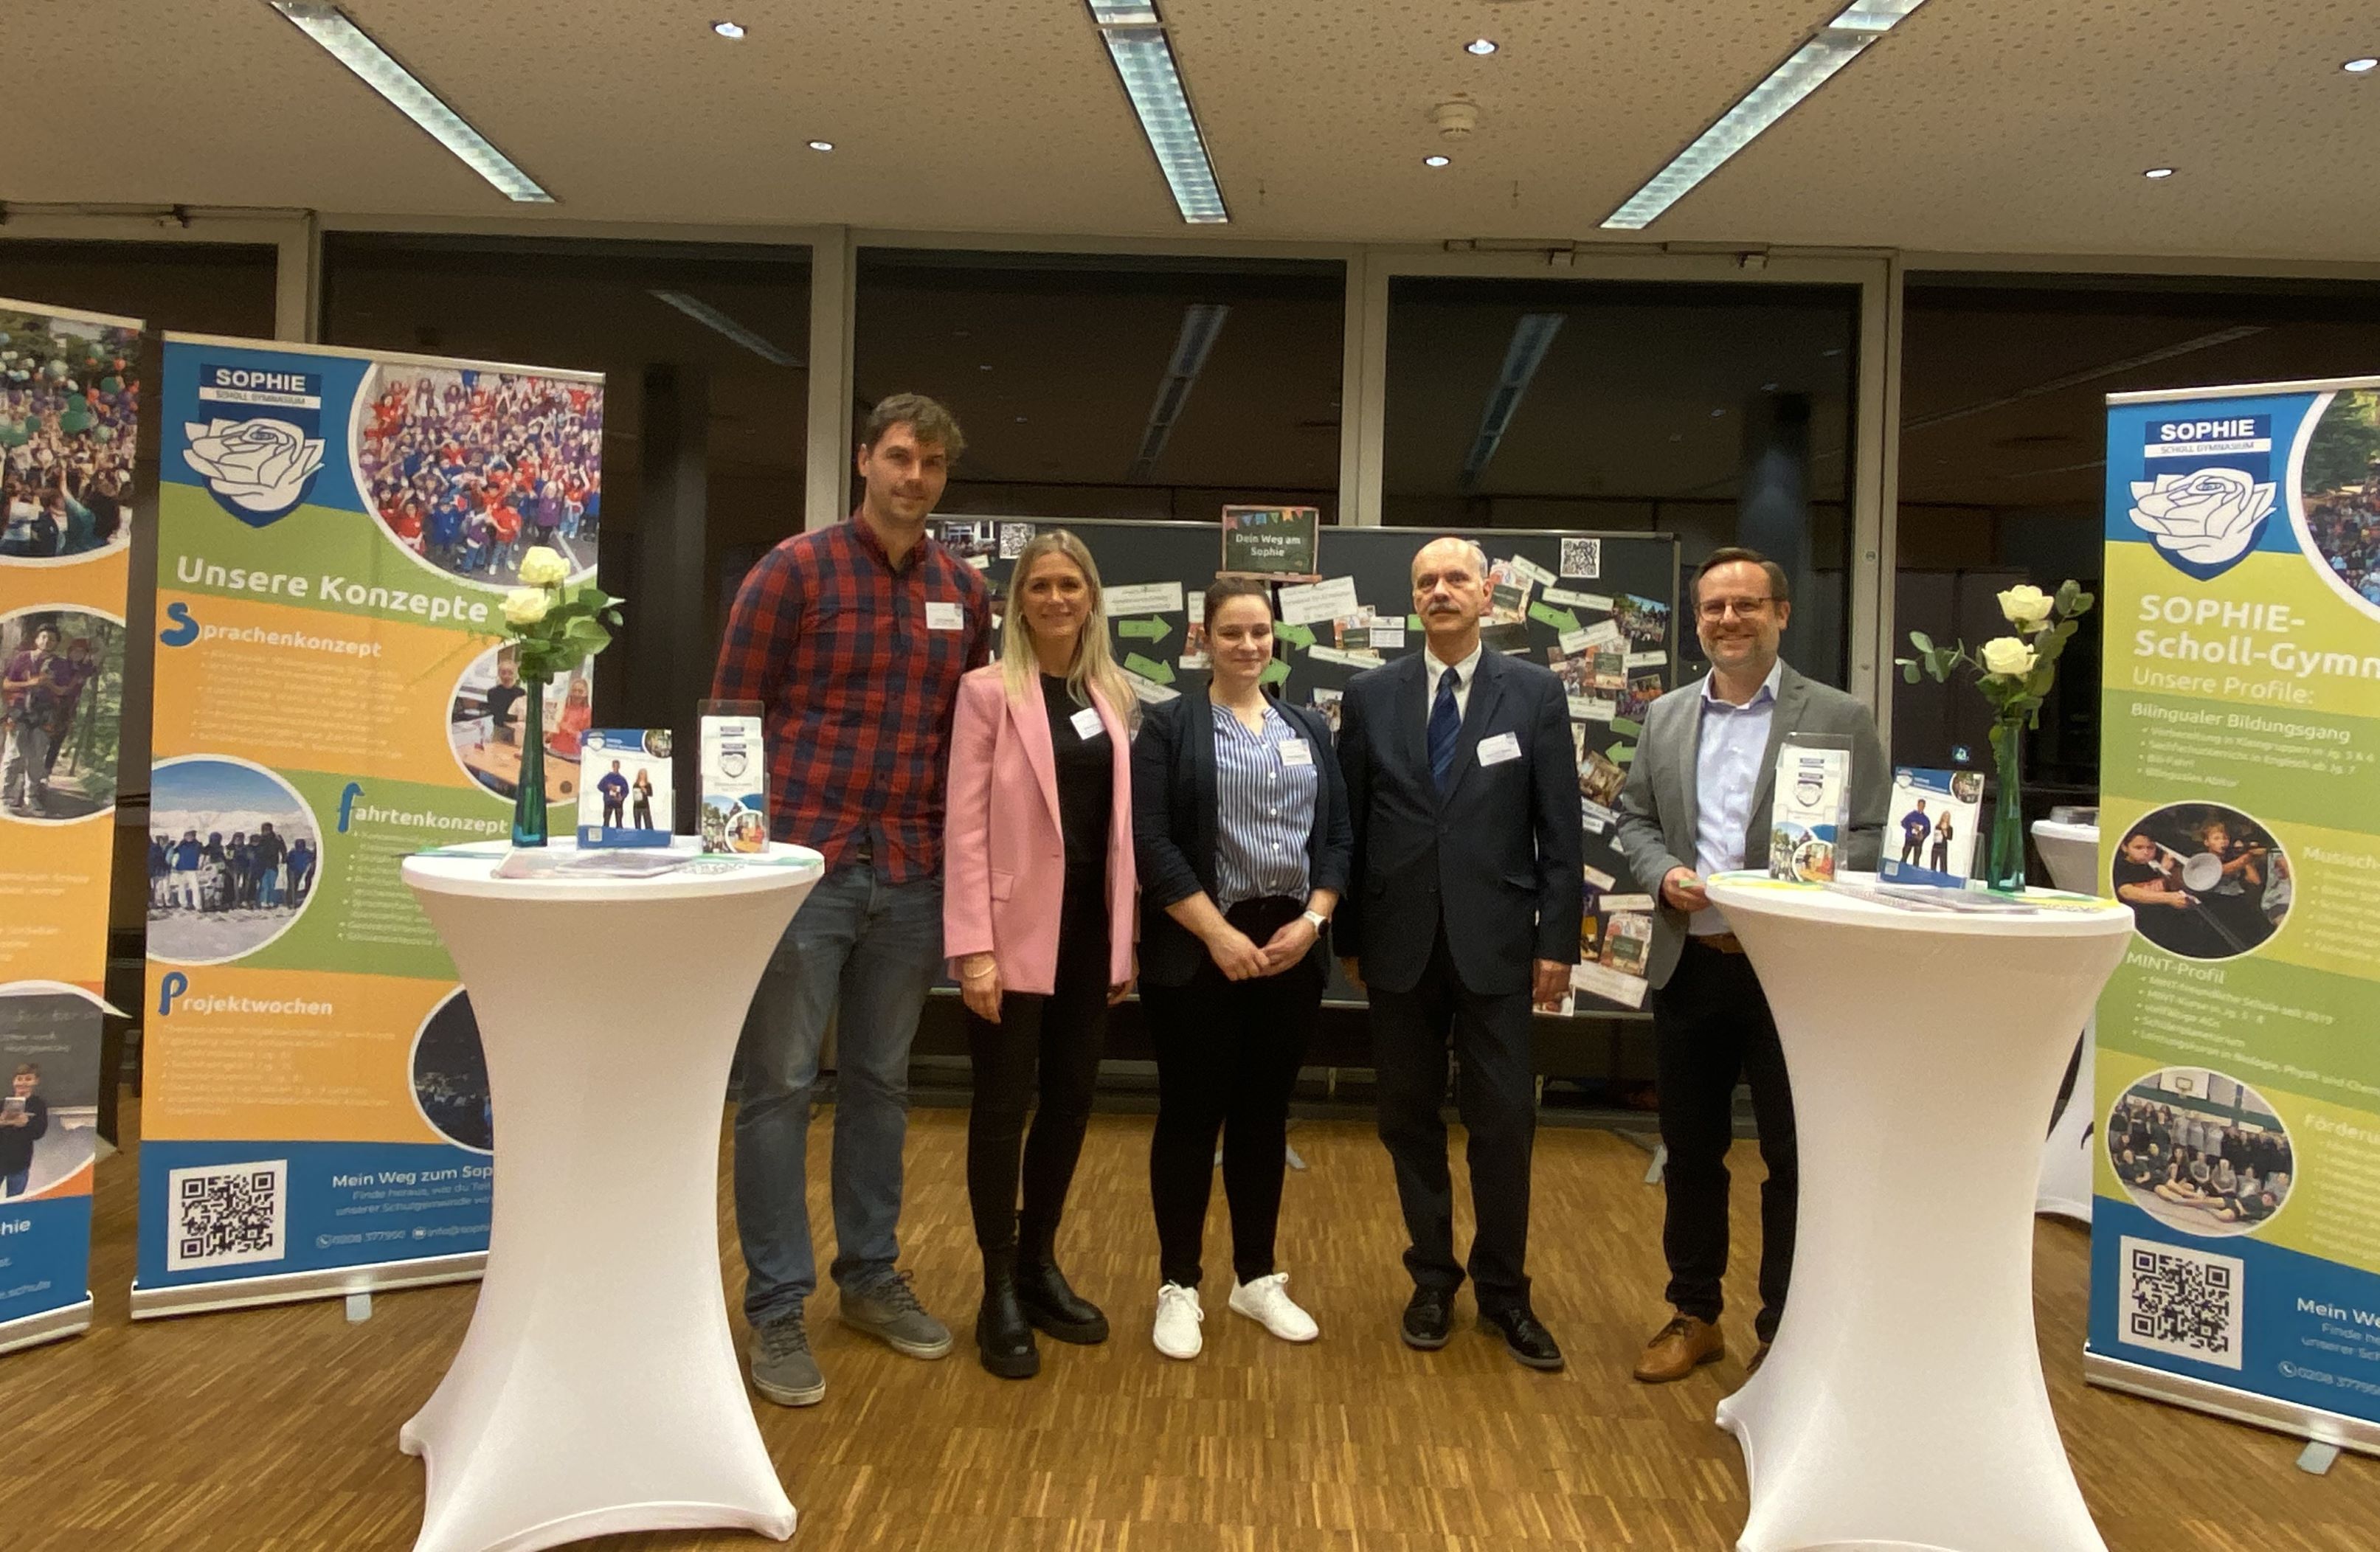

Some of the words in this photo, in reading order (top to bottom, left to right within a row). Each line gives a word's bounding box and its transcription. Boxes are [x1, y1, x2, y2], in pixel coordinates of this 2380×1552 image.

[216, 369, 306, 392] SOPHIE
[2160, 419, 2255, 441] SOPHIE
[1236, 533, 1259, 543] Dein
[1261, 534, 1284, 545] Weg
[1285, 536, 1301, 544] am
[1250, 546, 1285, 558] Sophie
[177, 555, 309, 597] Unsere
[319, 575, 489, 623] Konzepte
[2138, 594, 2306, 634] SOPHIE-
[2134, 629, 2380, 679] Scholl-Gymn
[2132, 665, 2216, 693] Unsere
[2224, 676, 2314, 704] Profile:
[2131, 702, 2222, 726] Bilingualer
[2227, 713, 2351, 745] Bildungsgang
[2125, 951, 2226, 985] MINT-Profil
[332, 1173, 373, 1188] Mein
[378, 1171, 417, 1185] Weg
[421, 1168, 457, 1182] zum
[2297, 1297, 2348, 1321] Mein
